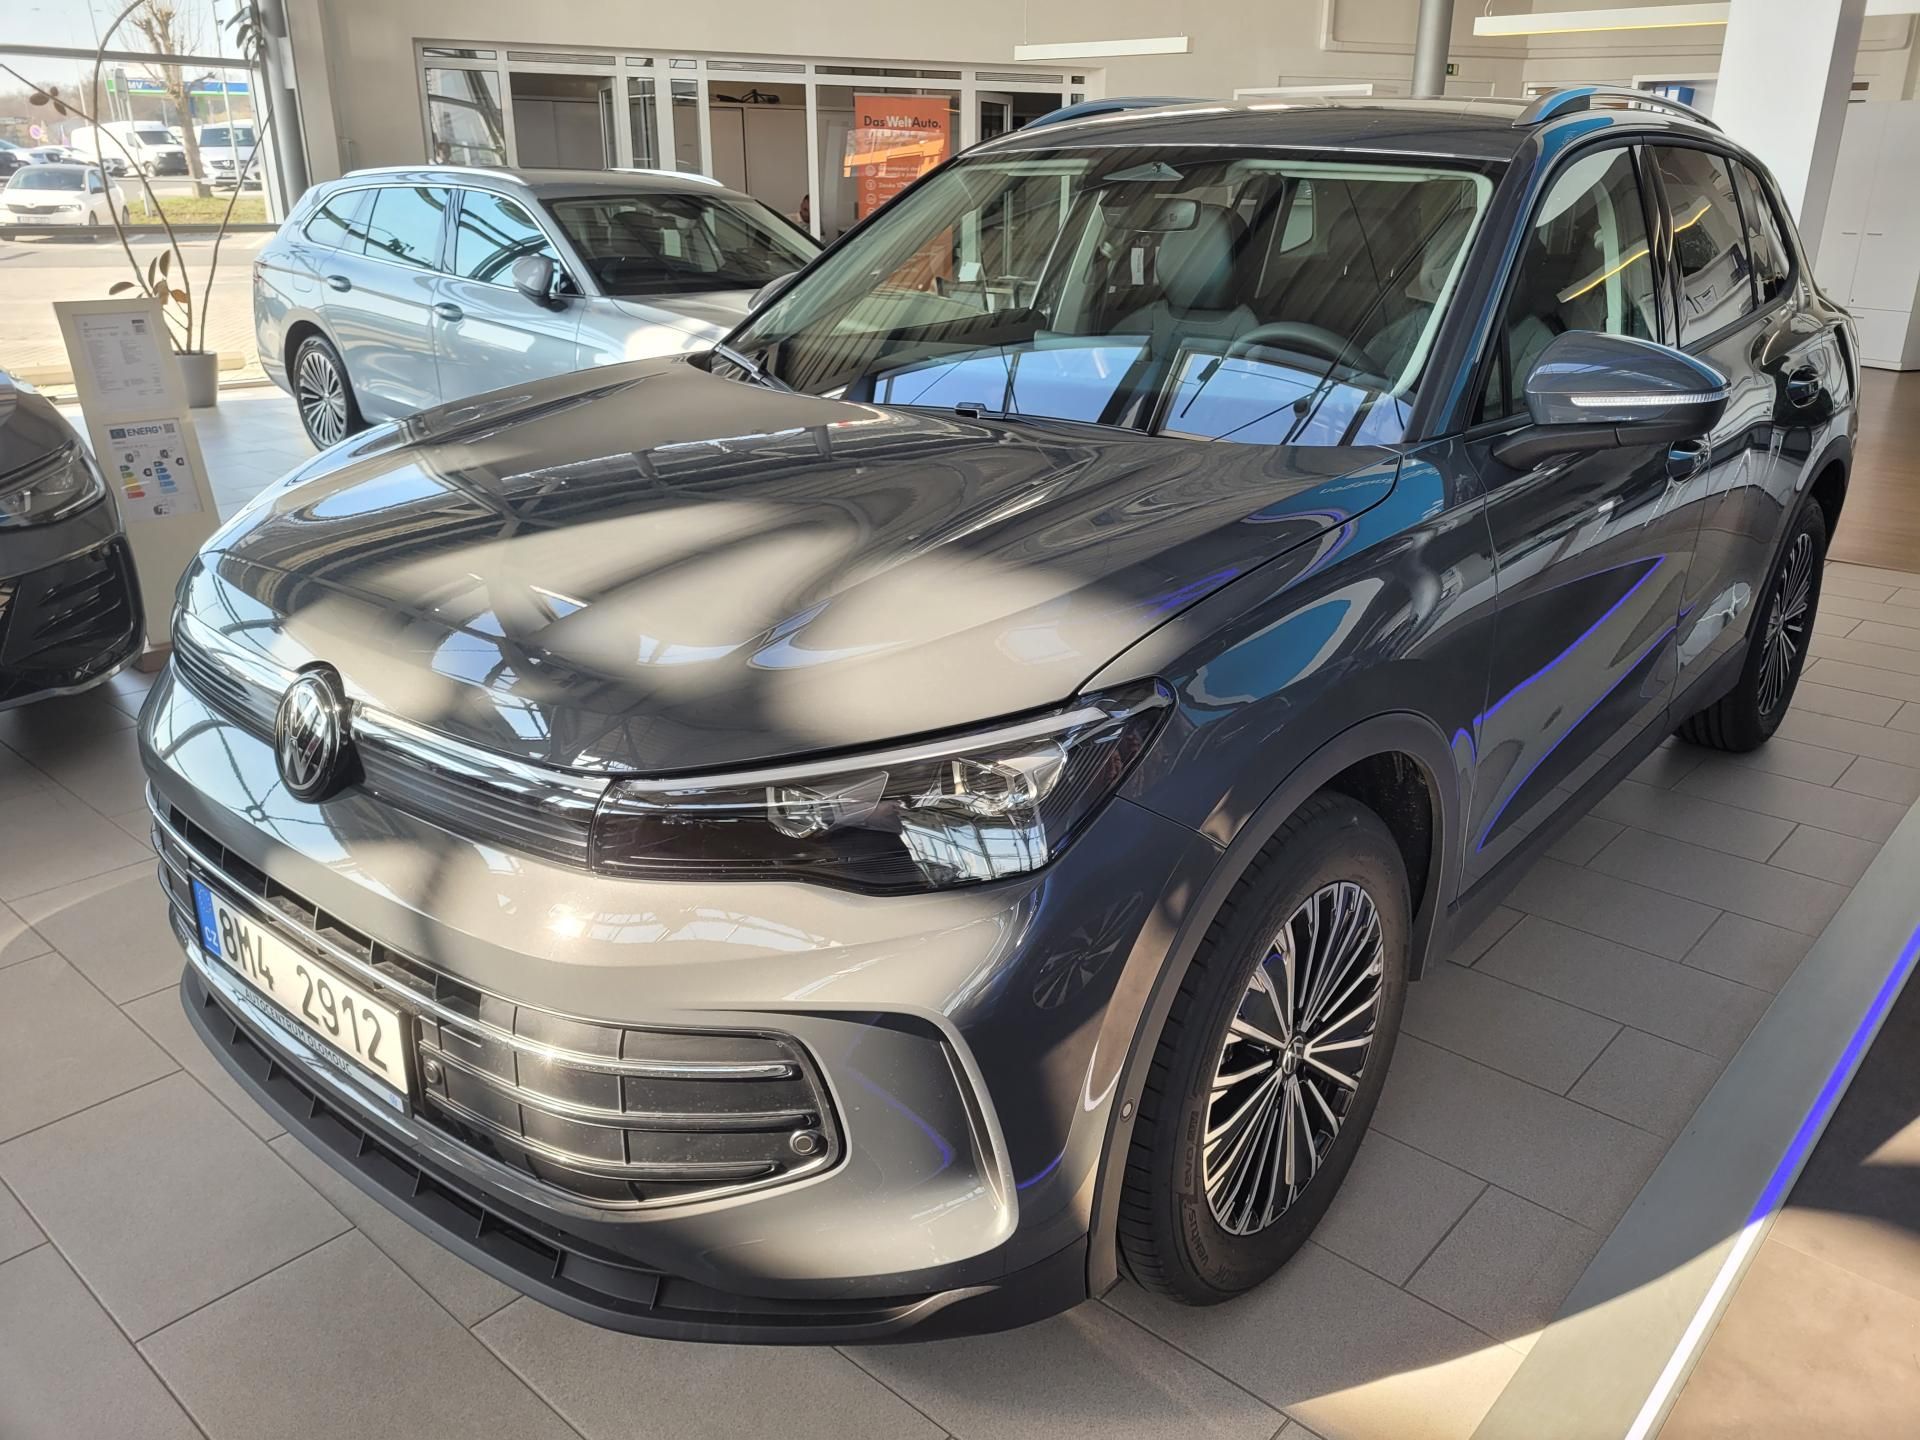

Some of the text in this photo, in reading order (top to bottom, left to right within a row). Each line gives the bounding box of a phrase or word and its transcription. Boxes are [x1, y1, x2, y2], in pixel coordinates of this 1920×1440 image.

[864, 116, 885, 126] Das
[204, 926, 219, 948] CZ
[219, 907, 388, 1072] 8M4 2912
[245, 988, 353, 1075] AUTOCENTRUM OLOMOUC
